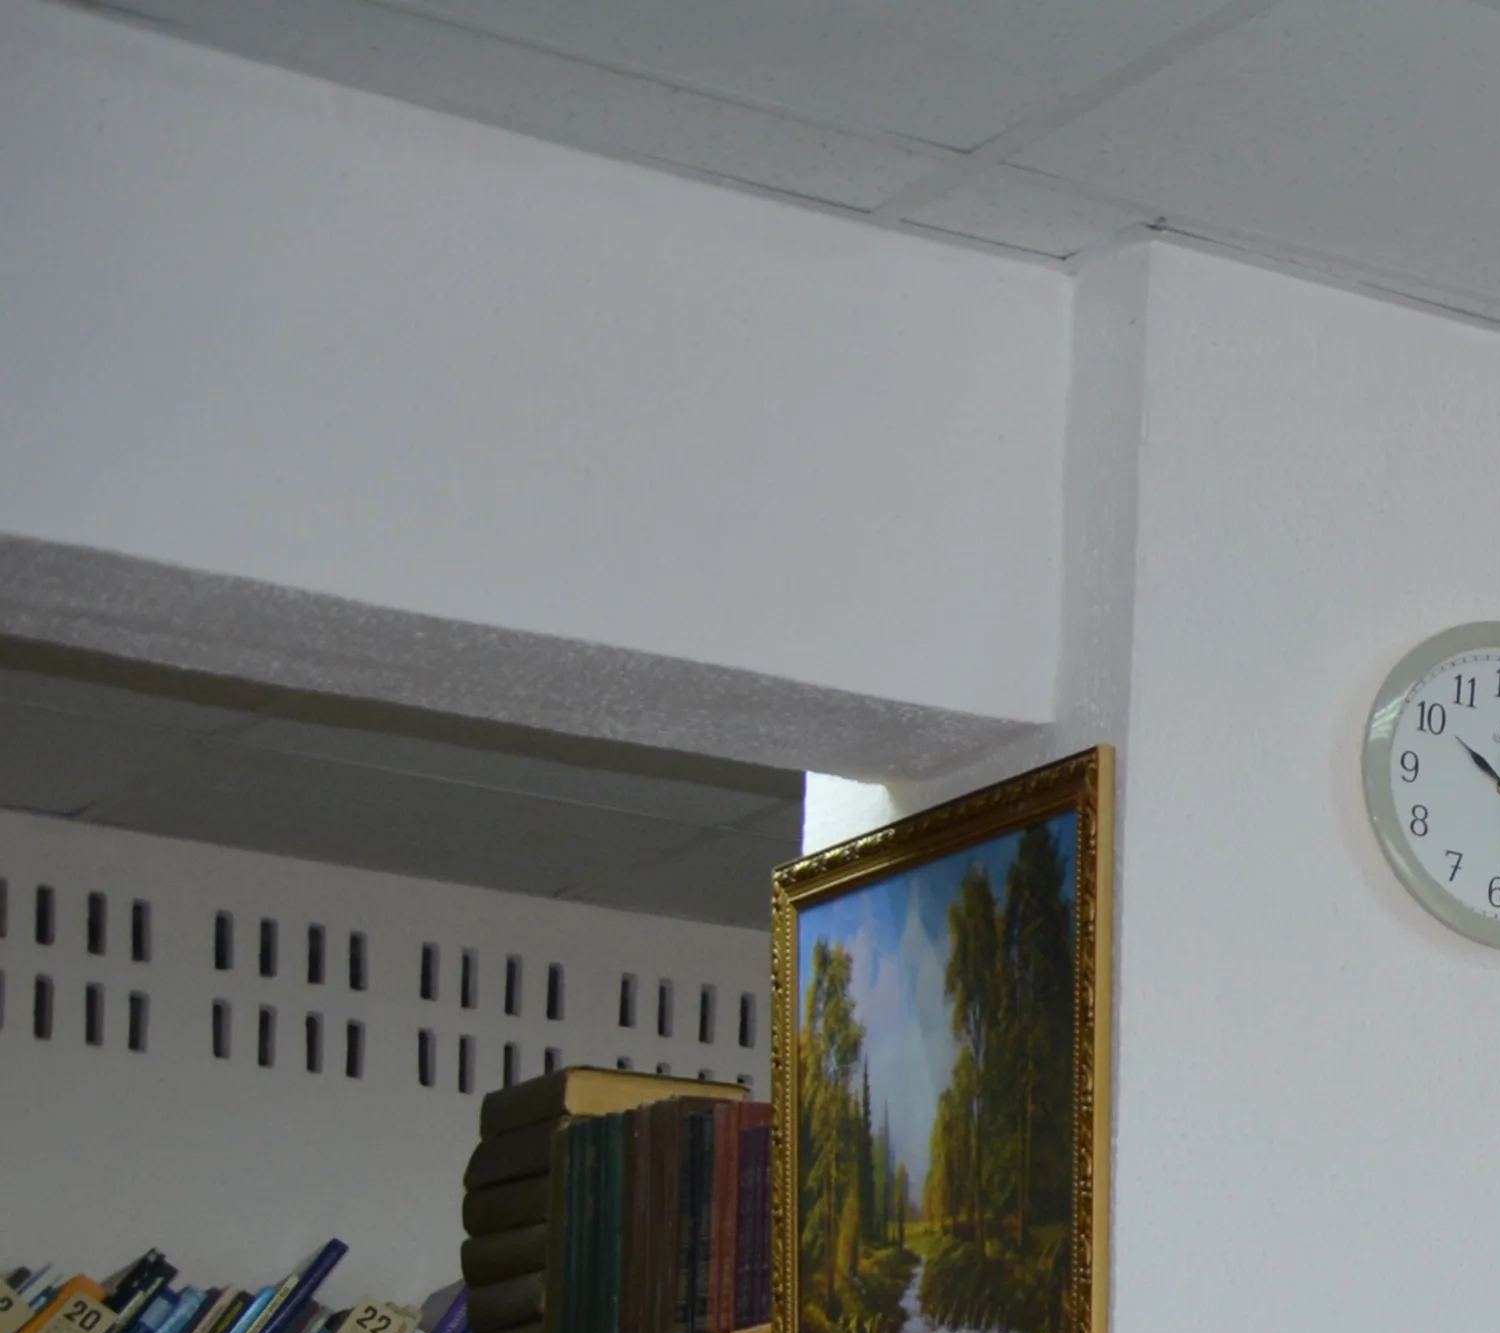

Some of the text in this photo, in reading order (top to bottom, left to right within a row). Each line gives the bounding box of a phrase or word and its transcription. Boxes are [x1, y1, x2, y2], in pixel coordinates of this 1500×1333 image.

[1452, 674, 1478, 708] 11
[1416, 701, 1446, 735] 10
[1400, 750, 1420, 783] 9
[1410, 805, 1429, 837] 8
[1445, 851, 1464, 882] 7
[64, 1300, 102, 1331] 20
